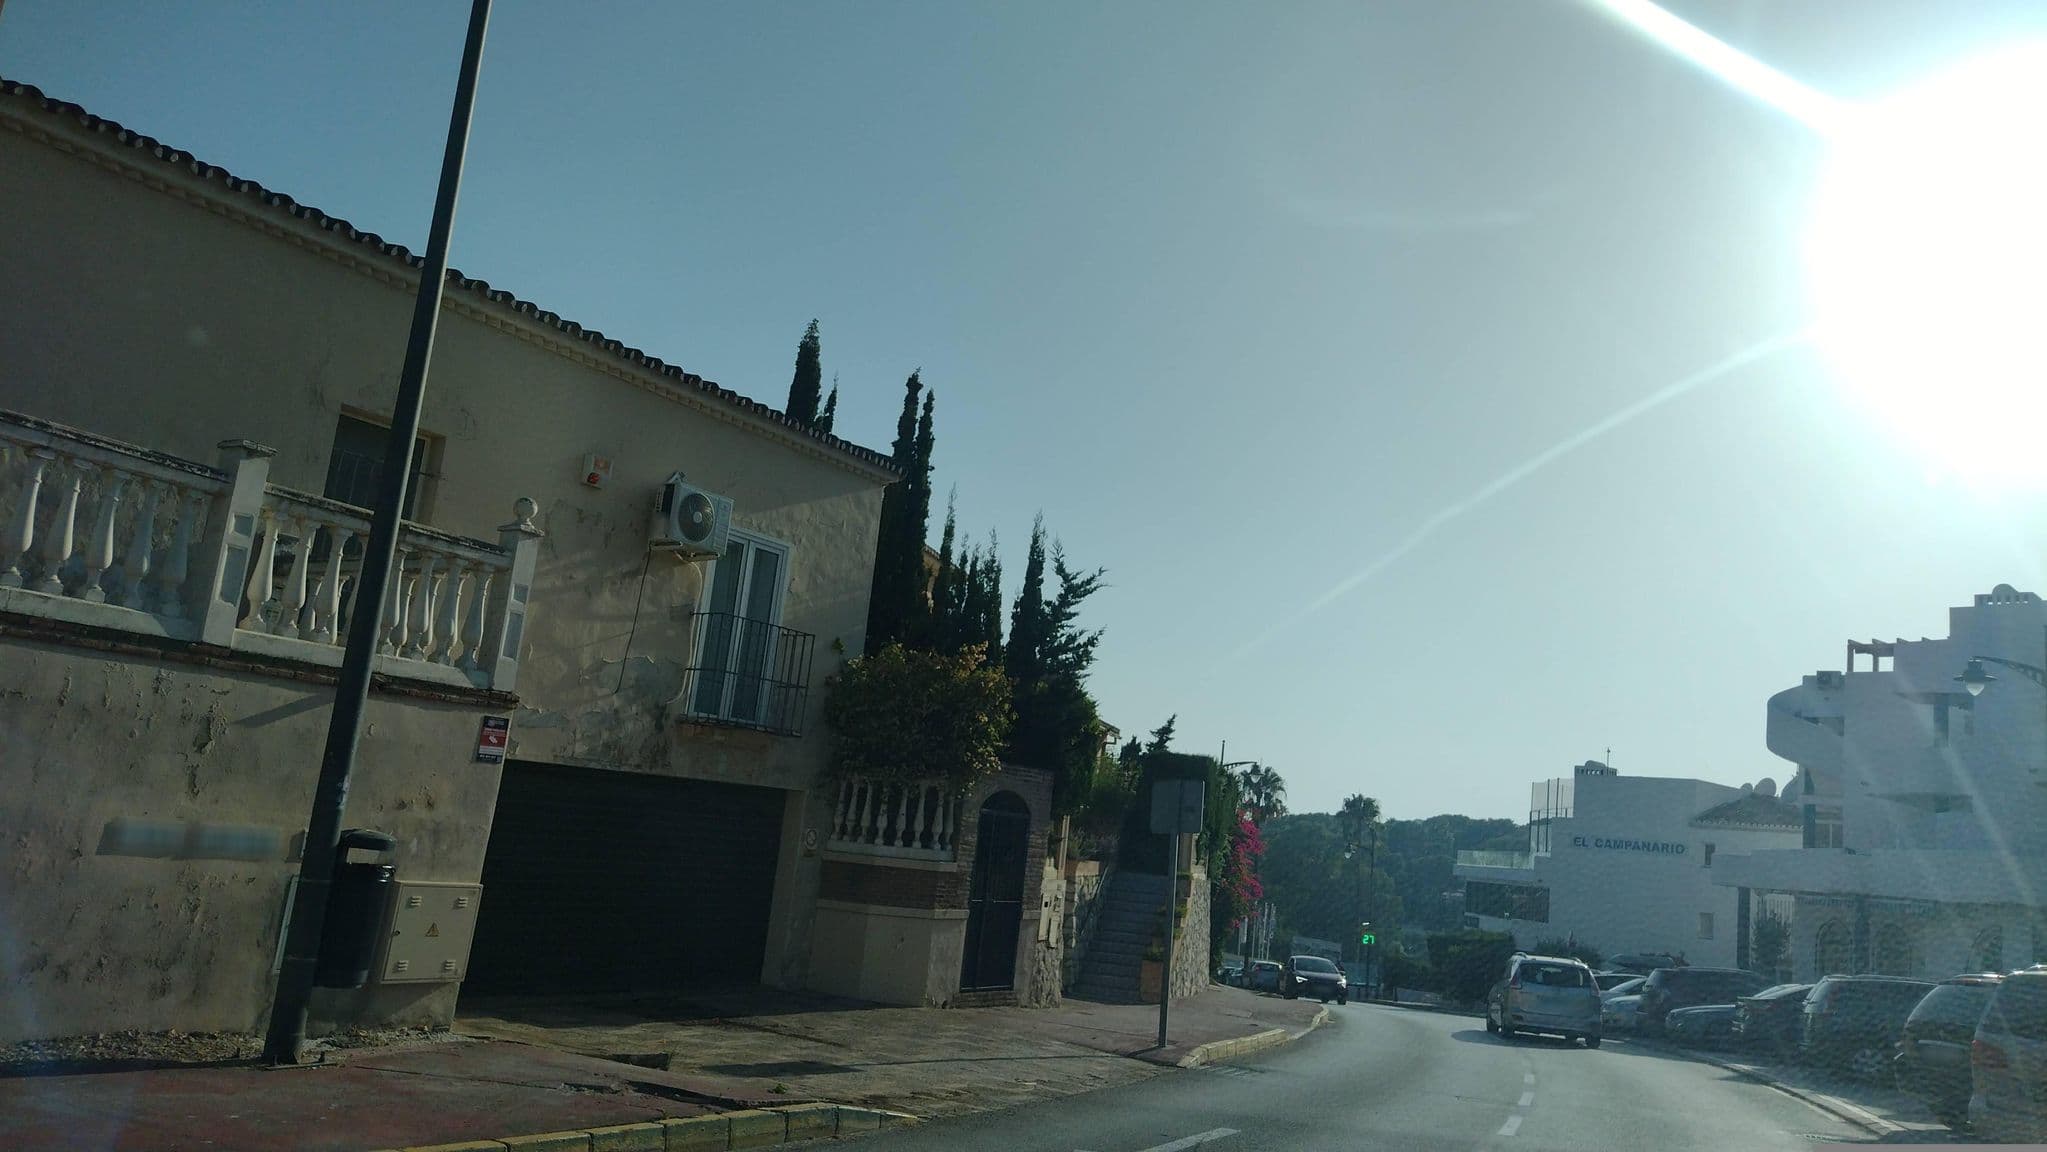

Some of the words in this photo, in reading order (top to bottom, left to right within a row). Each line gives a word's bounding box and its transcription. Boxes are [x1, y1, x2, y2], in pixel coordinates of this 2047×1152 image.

[1574, 837, 1588, 848] EL
[1594, 838, 1686, 854] CAMPANARIO
[1362, 934, 1374, 944] 27
